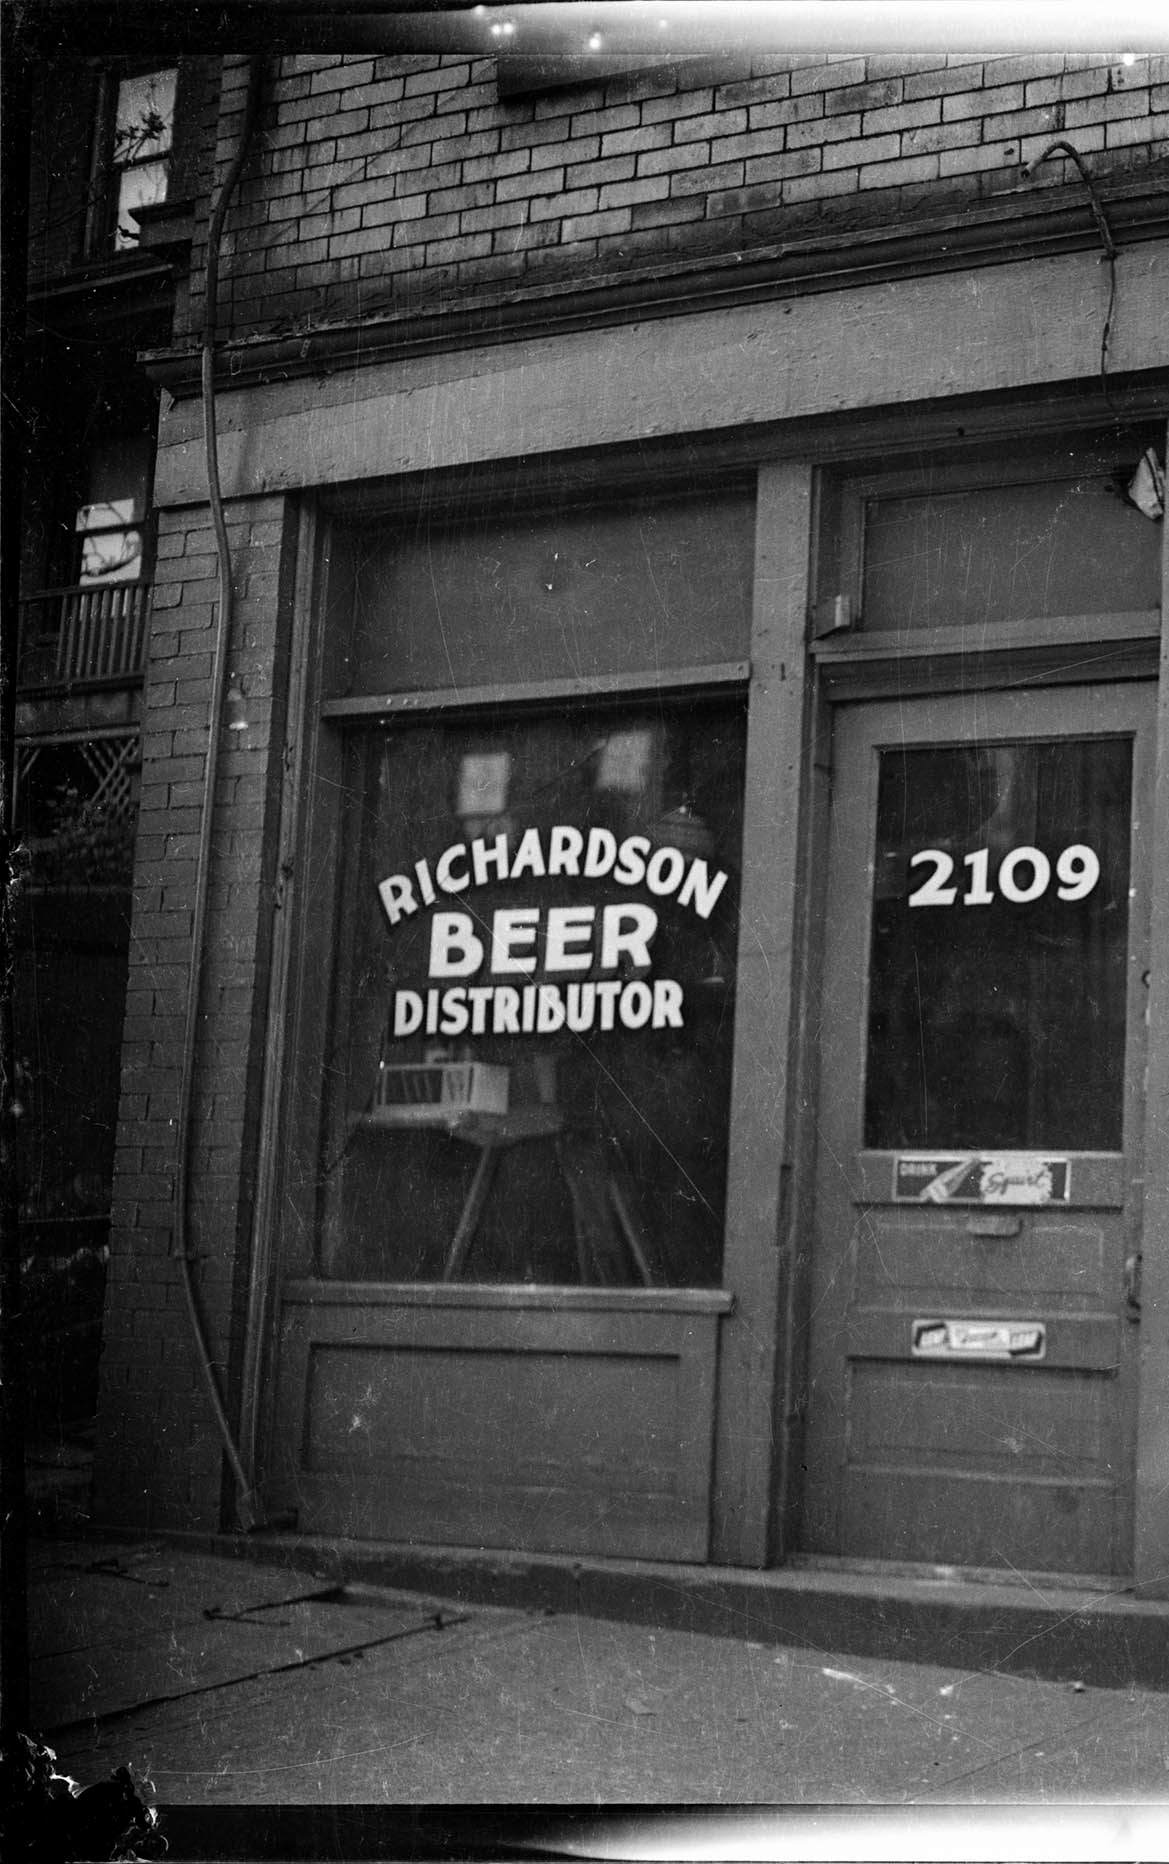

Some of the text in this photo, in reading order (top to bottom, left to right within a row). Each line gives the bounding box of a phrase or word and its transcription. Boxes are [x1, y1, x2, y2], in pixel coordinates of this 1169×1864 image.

[379, 826, 728, 924] RICHARDSON
[909, 844, 1100, 906] 2109
[429, 904, 659, 977] BEER
[395, 980, 684, 1036] DISTRIBUTOR
